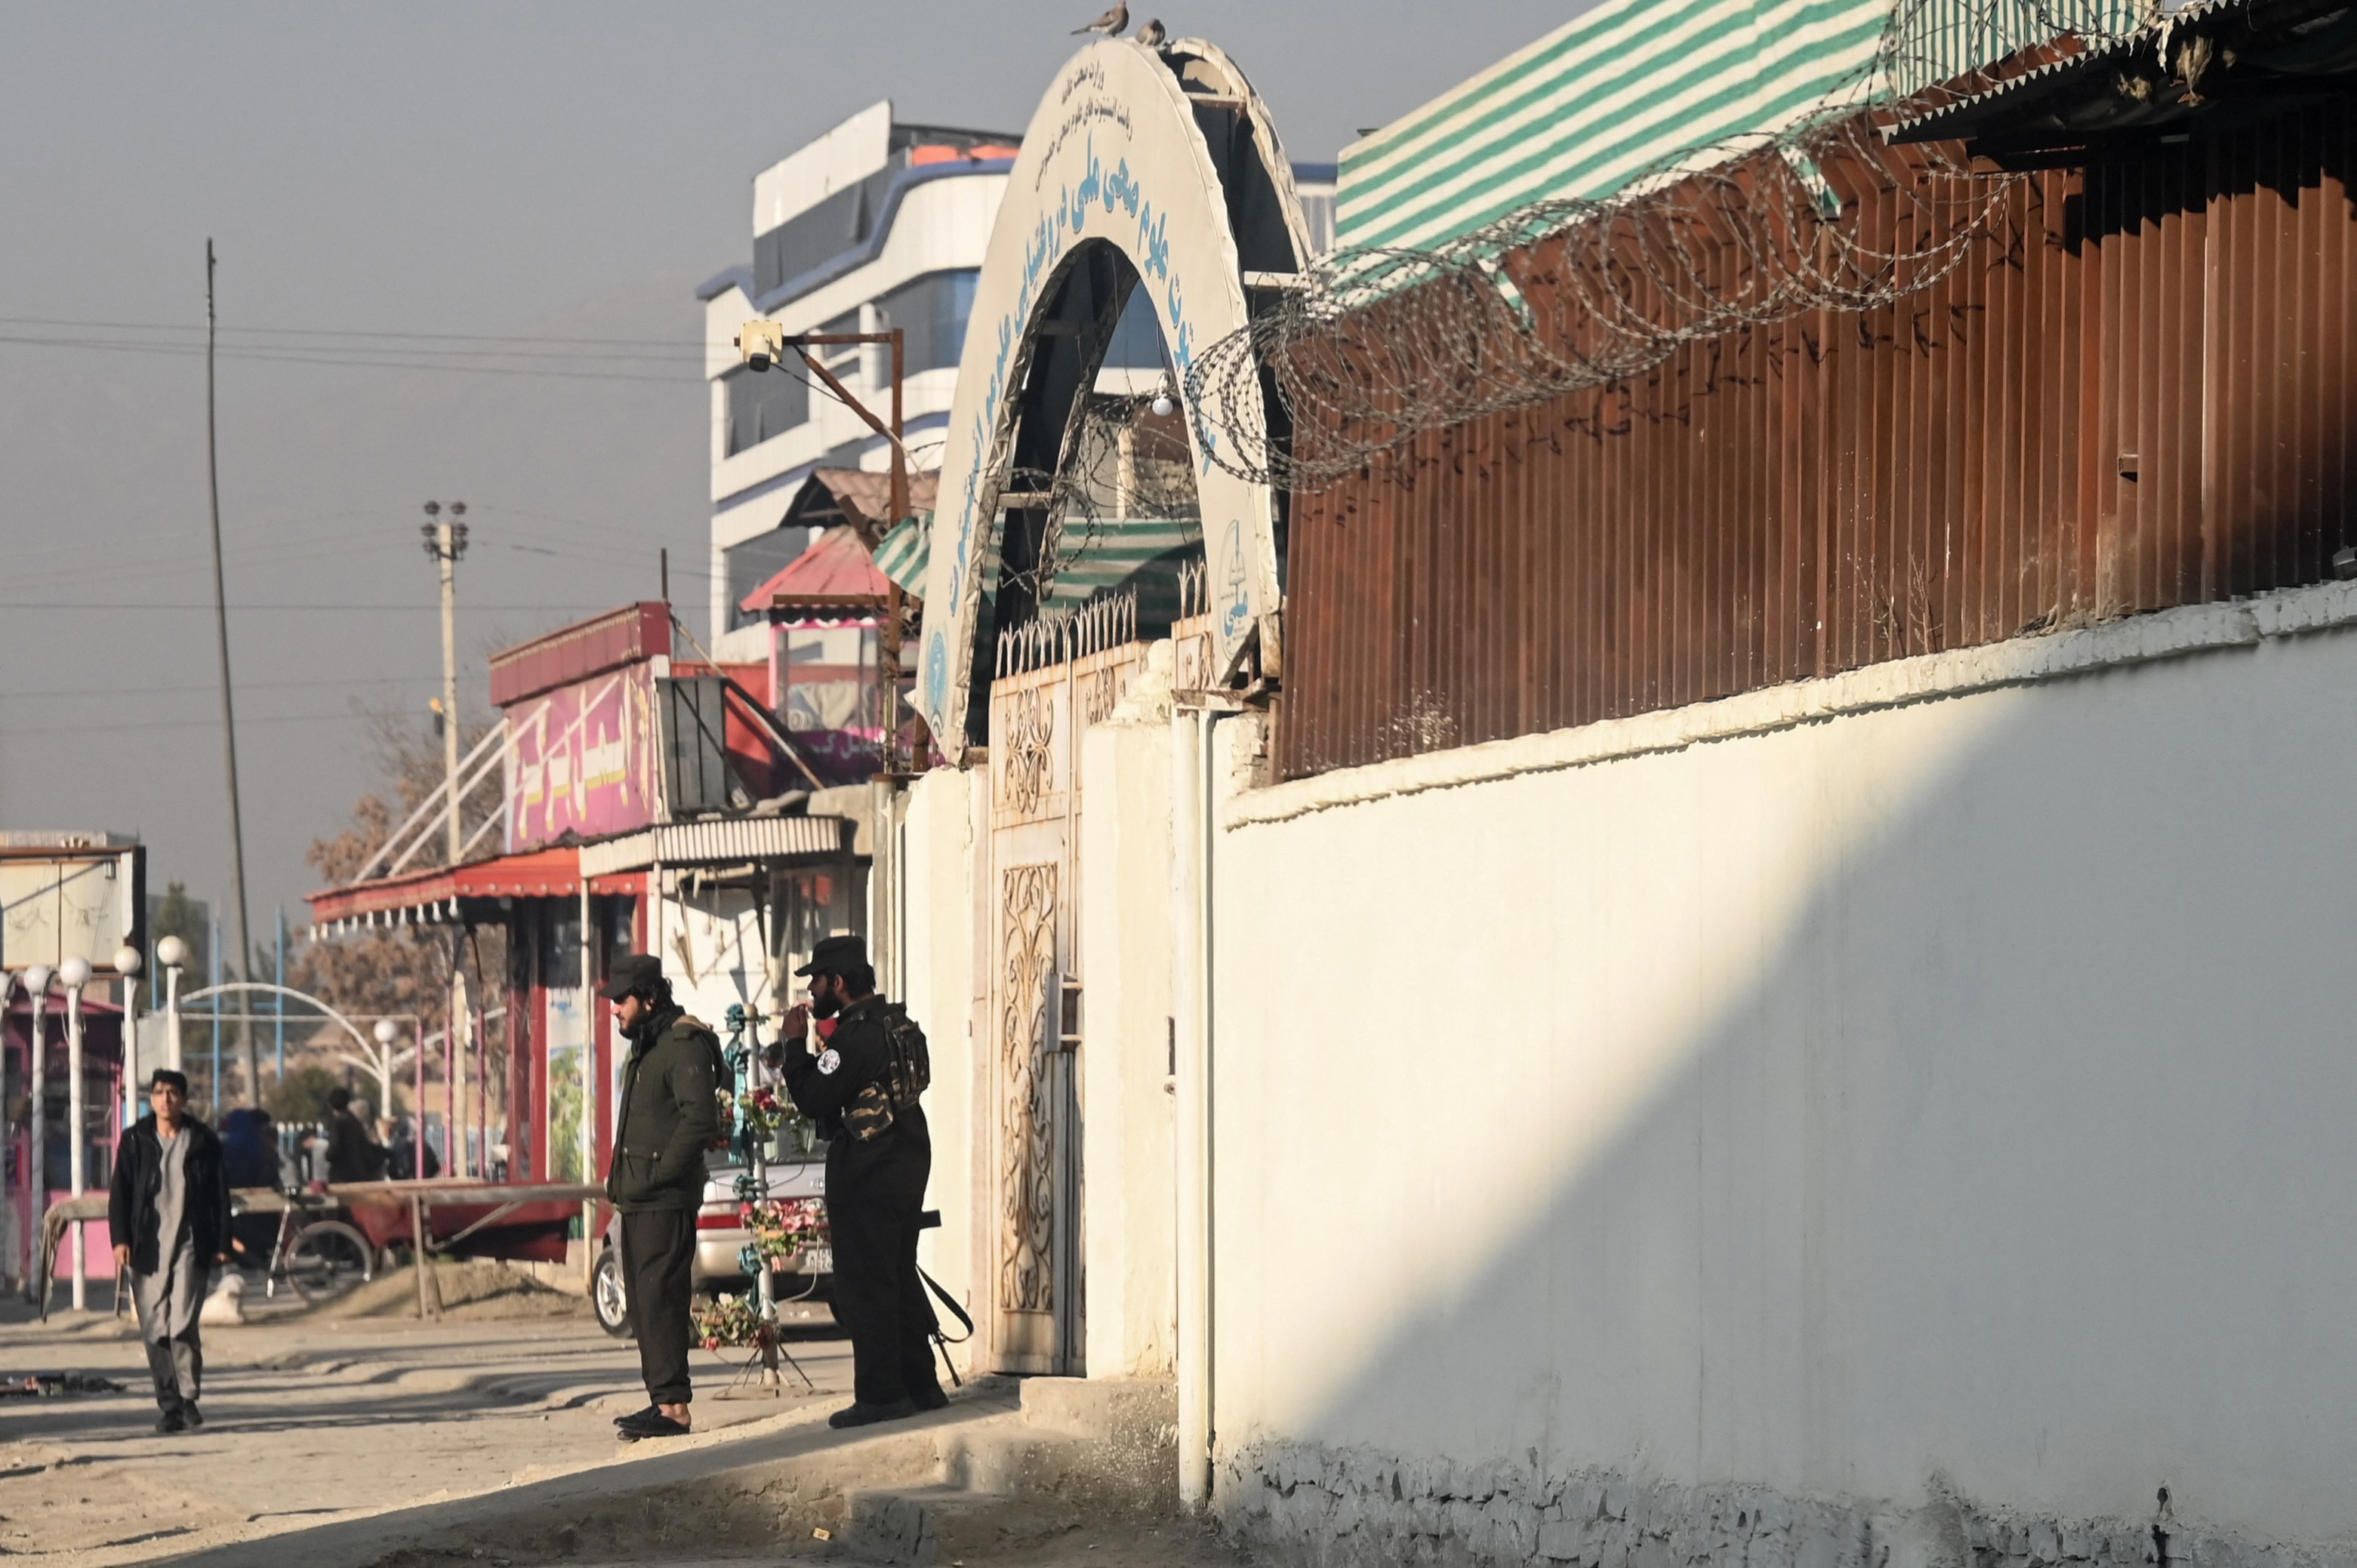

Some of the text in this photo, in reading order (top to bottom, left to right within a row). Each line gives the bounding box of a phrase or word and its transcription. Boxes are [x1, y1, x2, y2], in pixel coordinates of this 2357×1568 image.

[1074, 66, 1089, 89] صحت
[1089, 59, 1105, 91] وزارت
[1071, 101, 1083, 137] علوم
[1083, 96, 1093, 127] های
[1117, 106, 1133, 142] ریاست
[1056, 119, 1071, 153] صحی
[1036, 134, 1055, 193] خصوصی
[1071, 129, 1100, 234] ملی
[1103, 156, 1140, 218] صحی
[1137, 200, 1169, 284] علوم
